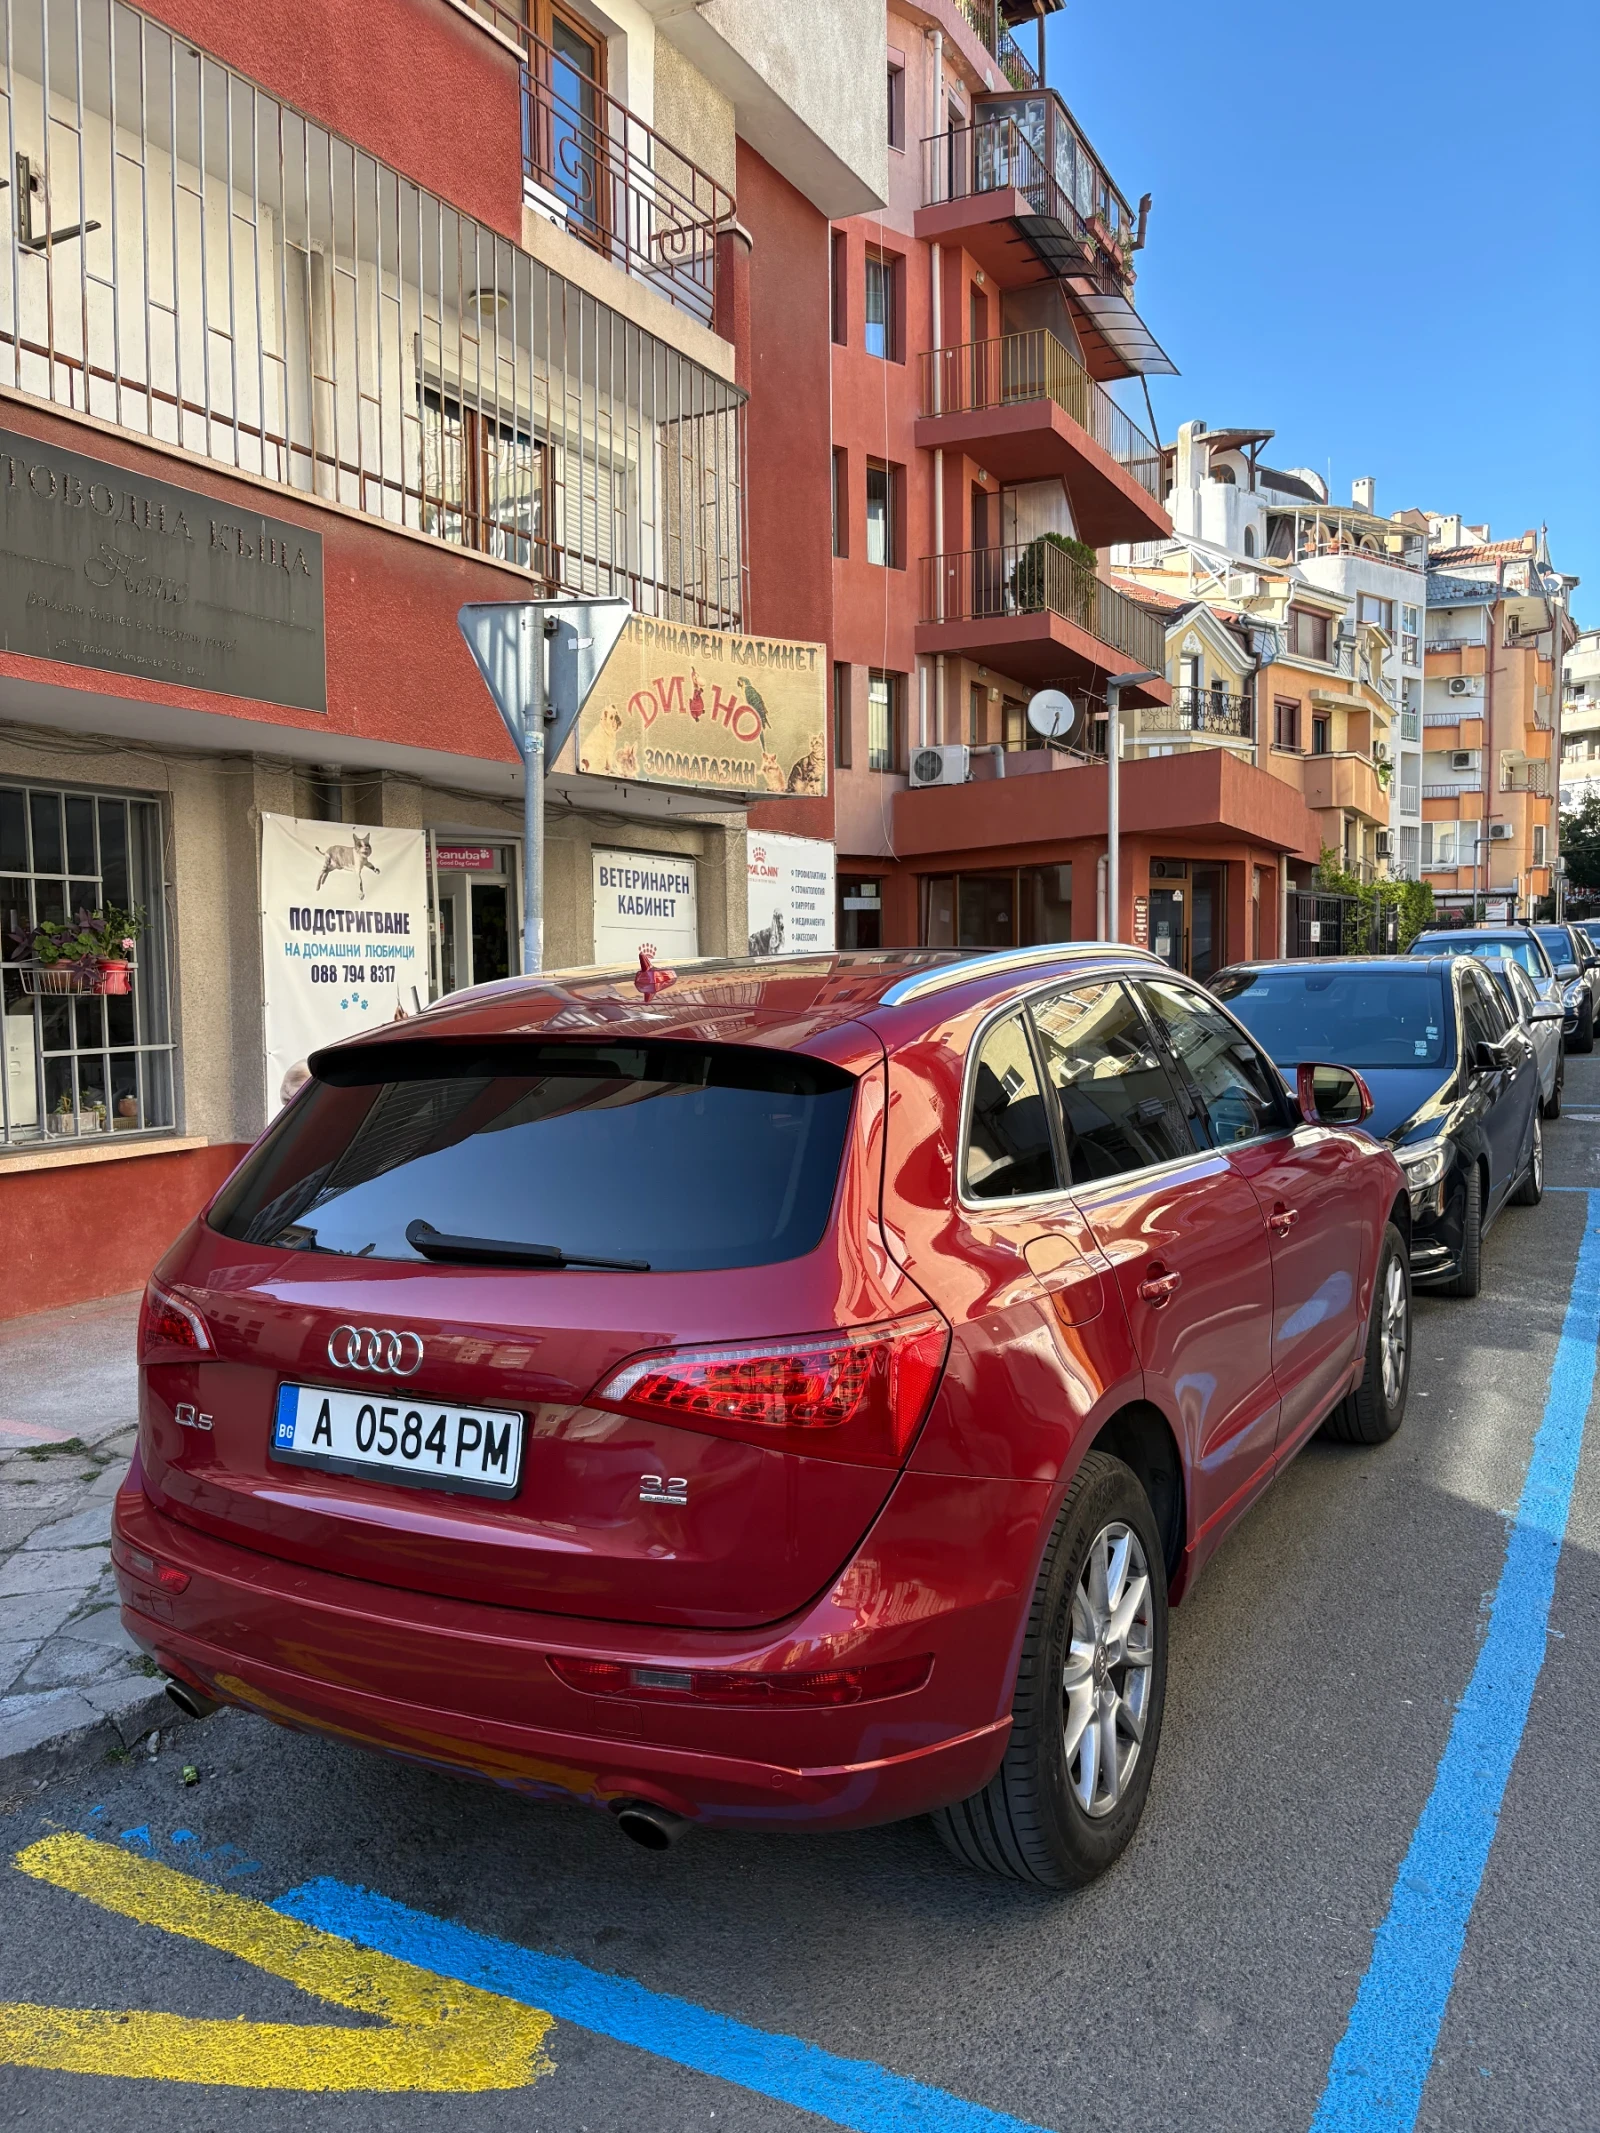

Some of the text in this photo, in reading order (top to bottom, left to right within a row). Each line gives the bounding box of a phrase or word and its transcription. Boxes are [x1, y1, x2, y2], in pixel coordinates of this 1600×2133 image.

[207, 519, 312, 577] КЪЩА
[622, 616, 818, 672] ТЕРИНАРЕН КАБИНЕТ
[643, 748, 757, 785] ЗООМАГАЗИН
[599, 865, 691, 895] ВЕТЕРИНАРЕН
[617, 894, 676, 918] КАБИНЕТ
[289, 907, 411, 935] ПОДСТРИГВАНЕ
[284, 942, 415, 960] НА ДОМАШНИ ЛЮБИМЦИ
[310, 964, 396, 983] 088 794 8317
[174, 1404, 215, 1431] Q5
[278, 1423, 294, 1439] BG
[311, 1398, 332, 1447] A
[639, 1473, 689, 1495] 3.2
